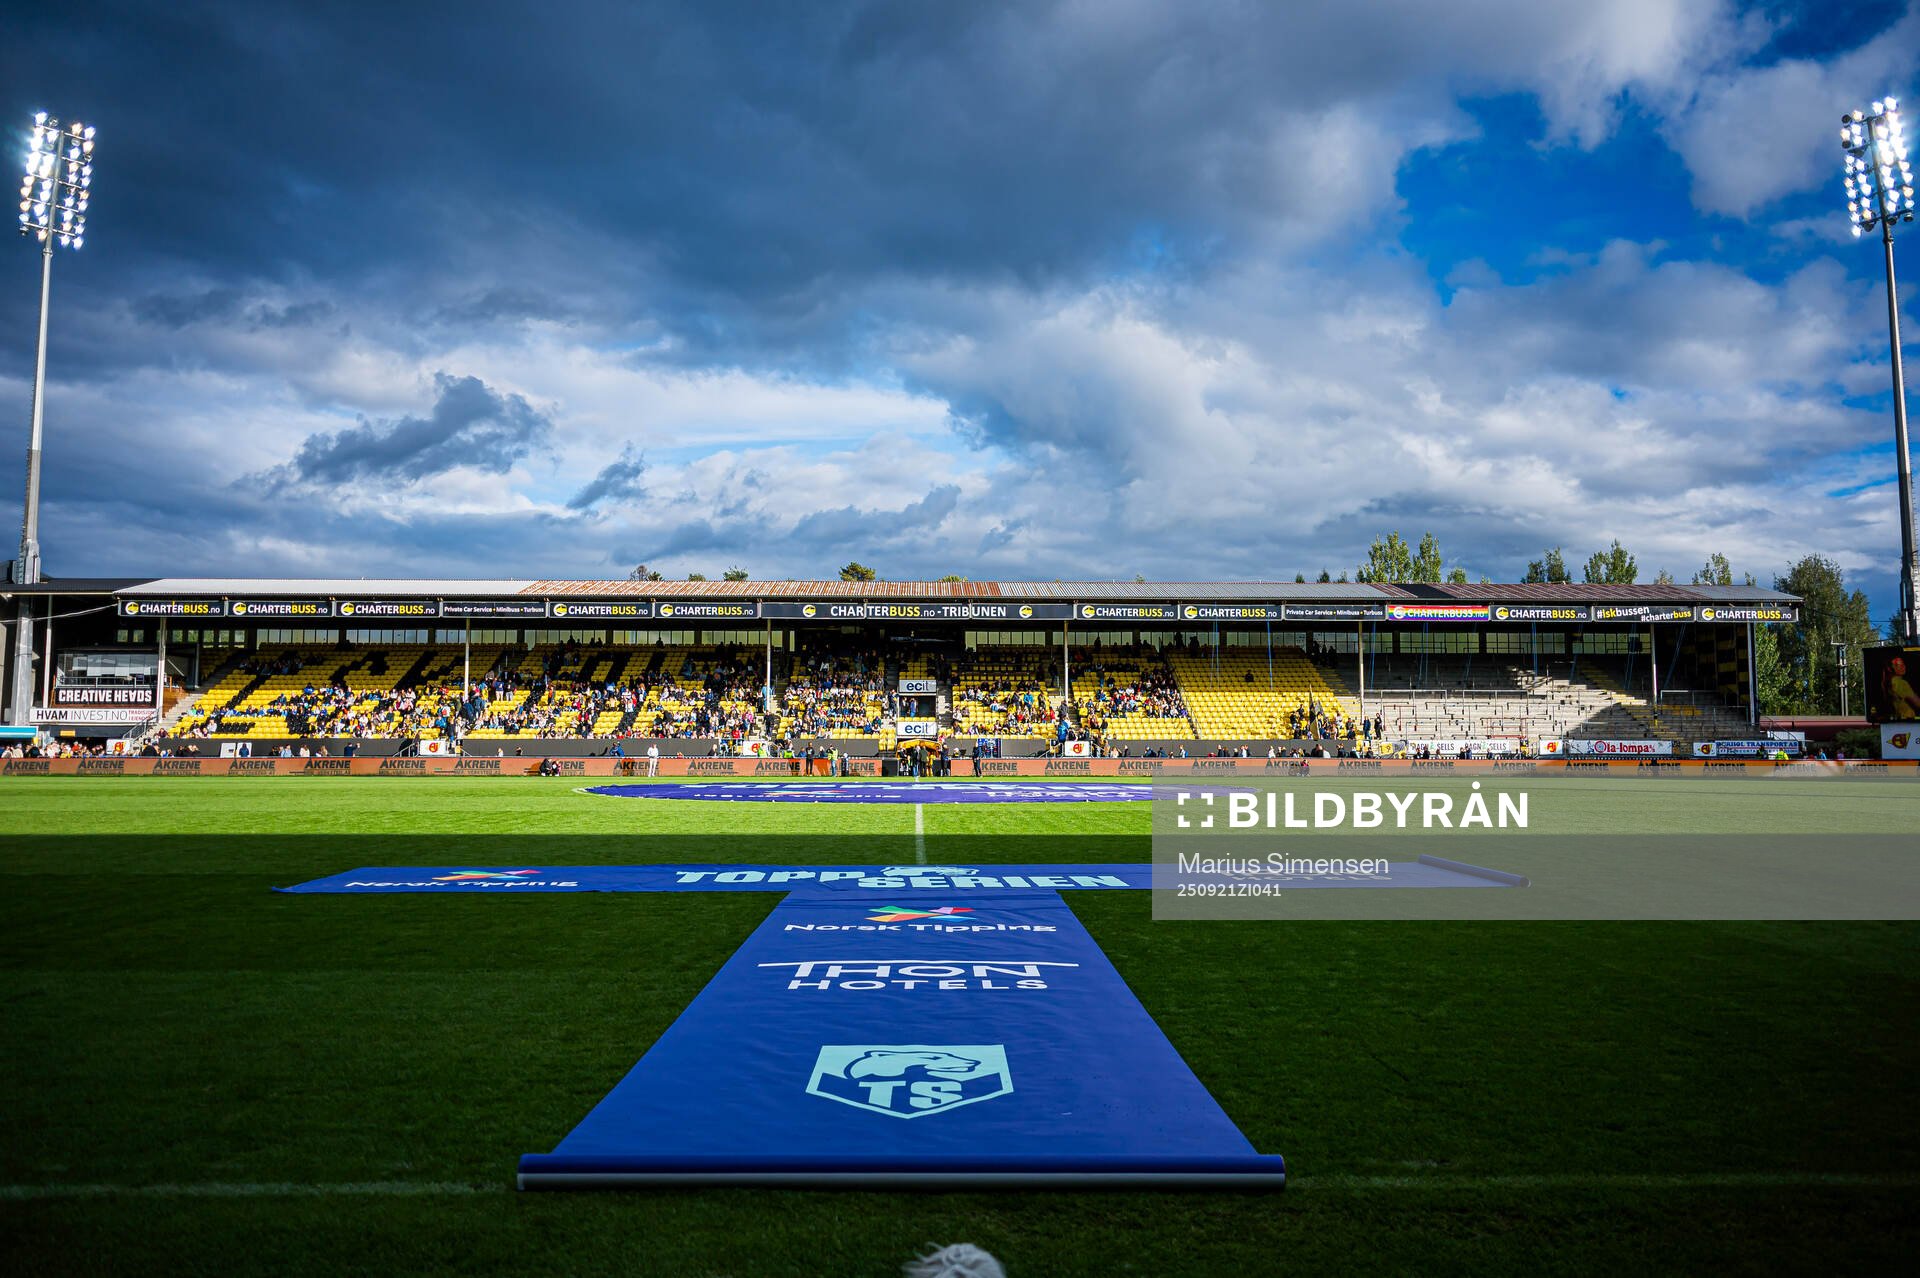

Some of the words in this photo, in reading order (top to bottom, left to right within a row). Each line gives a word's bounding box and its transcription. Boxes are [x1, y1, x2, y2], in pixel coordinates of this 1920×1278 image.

[140, 605, 220, 613] CHARTERBUSS.no
[248, 605, 328, 613] CHARTERBUSS.no
[355, 605, 435, 614] CHARTERBUSS.no
[568, 606, 648, 614] CHARTERBUSS.no
[674, 606, 754, 615] CHARTERBUSS.no
[830, 606, 935, 616] CHARTERBUSS.no
[1096, 608, 1174, 616] CHARTERBUSS.no
[1199, 608, 1278, 617] CHARTERBUSS.no
[1408, 609, 1484, 617] CHARTERBUSS.no
[1510, 609, 1587, 618] CHARTERBUSS.no
[1715, 610, 1792, 619] CHARTERBUSS.no
[906, 680, 929, 691] ecit
[58, 690, 113, 702] CREATIVE
[36, 710, 68, 720] HVAM
[70, 710, 128, 720] INVEST.NO
[904, 723, 929, 733] ecit
[1490, 743, 1506, 751] SELLS
[78, 759, 124, 769] ÅKRENE
[153, 759, 201, 769] ÅKRENE
[229, 758, 275, 769] ÅKRENE
[305, 758, 351, 768] ÅKRENE
[379, 758, 426, 768] ÅKRENE
[455, 757, 500, 768] ÅKRENE
[688, 759, 734, 769] ÅKRENE
[755, 759, 800, 770] ÅKRENE
[981, 762, 1017, 770] KRENE
[1045, 759, 1090, 770] ÅKRENE
[1119, 759, 1163, 769] ÅKRENE
[908, 924, 1057, 933] Tipping
[758, 959, 1079, 978] THON
[787, 980, 1048, 990] HOTELS
[858, 1080, 963, 1109] TS
